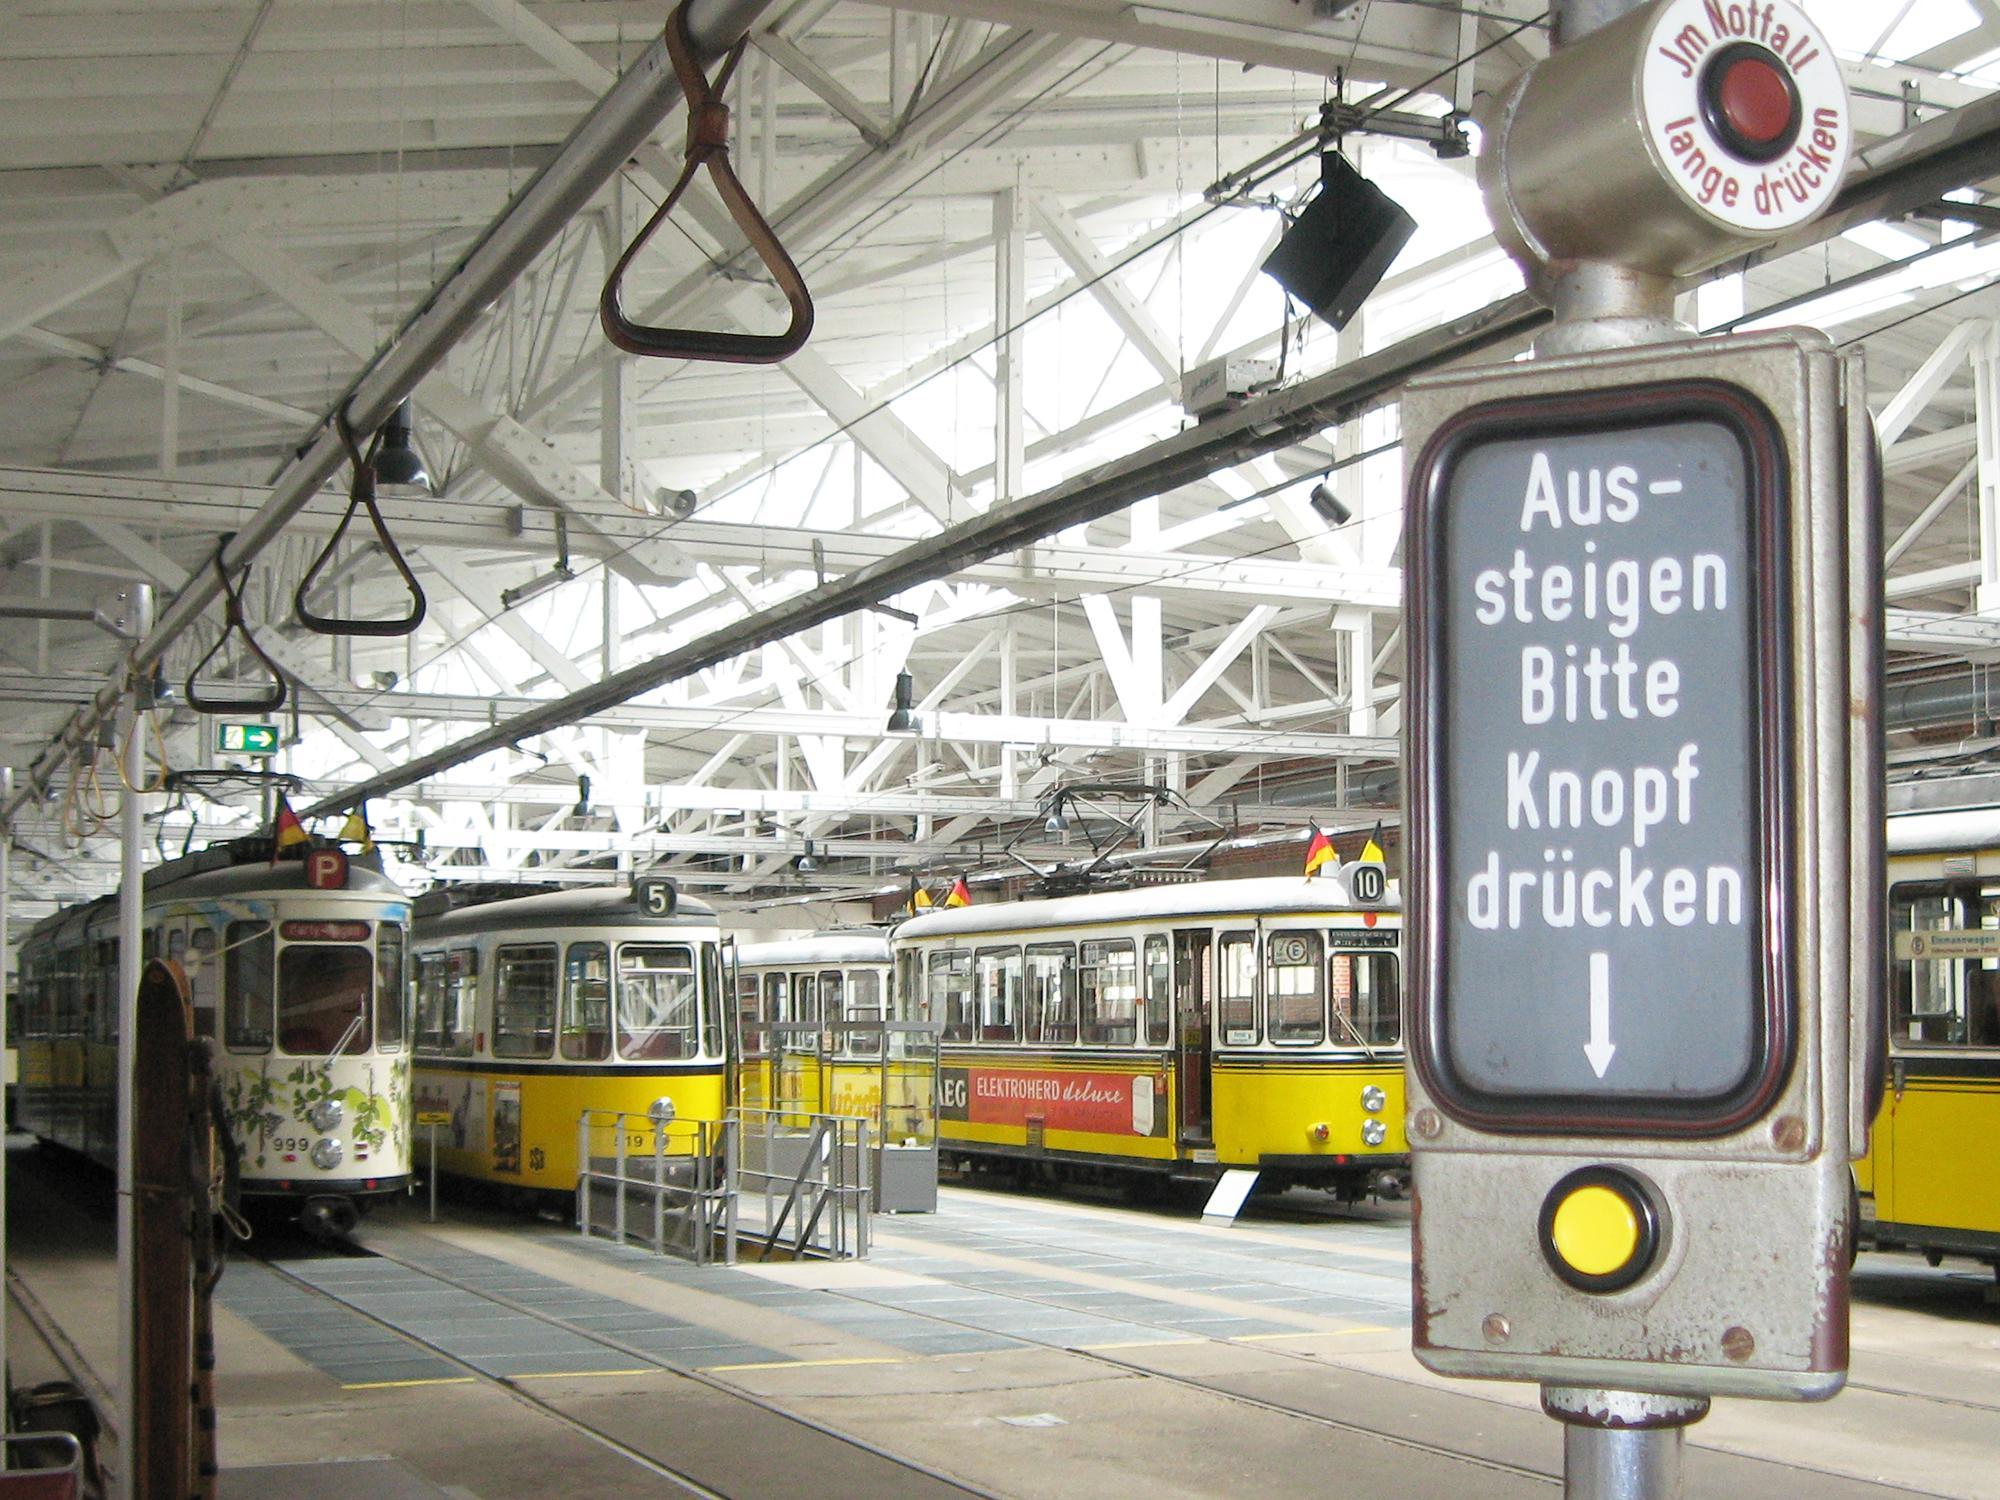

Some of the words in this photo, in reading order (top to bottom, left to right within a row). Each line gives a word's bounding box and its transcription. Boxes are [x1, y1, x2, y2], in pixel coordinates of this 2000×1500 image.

[1703, 0, 1819, 75] Notfall
[1664, 116, 1740, 208] lange
[1754, 107, 1839, 215] drücken
[1521, 453, 1682, 531] Aus-
[1475, 541, 1726, 638] steigen
[1522, 643, 1679, 724] Bitte
[1508, 743, 1699, 847] Knopf
[316, 855, 339, 887] P
[648, 885, 666, 914] 5
[1357, 870, 1379, 898] 10
[1468, 846, 1741, 929] drücken
[976, 1076, 1060, 1101] ELEKTROHERD
[1062, 1079, 1124, 1104] deluxe
[273, 1137, 309, 1152] 999
